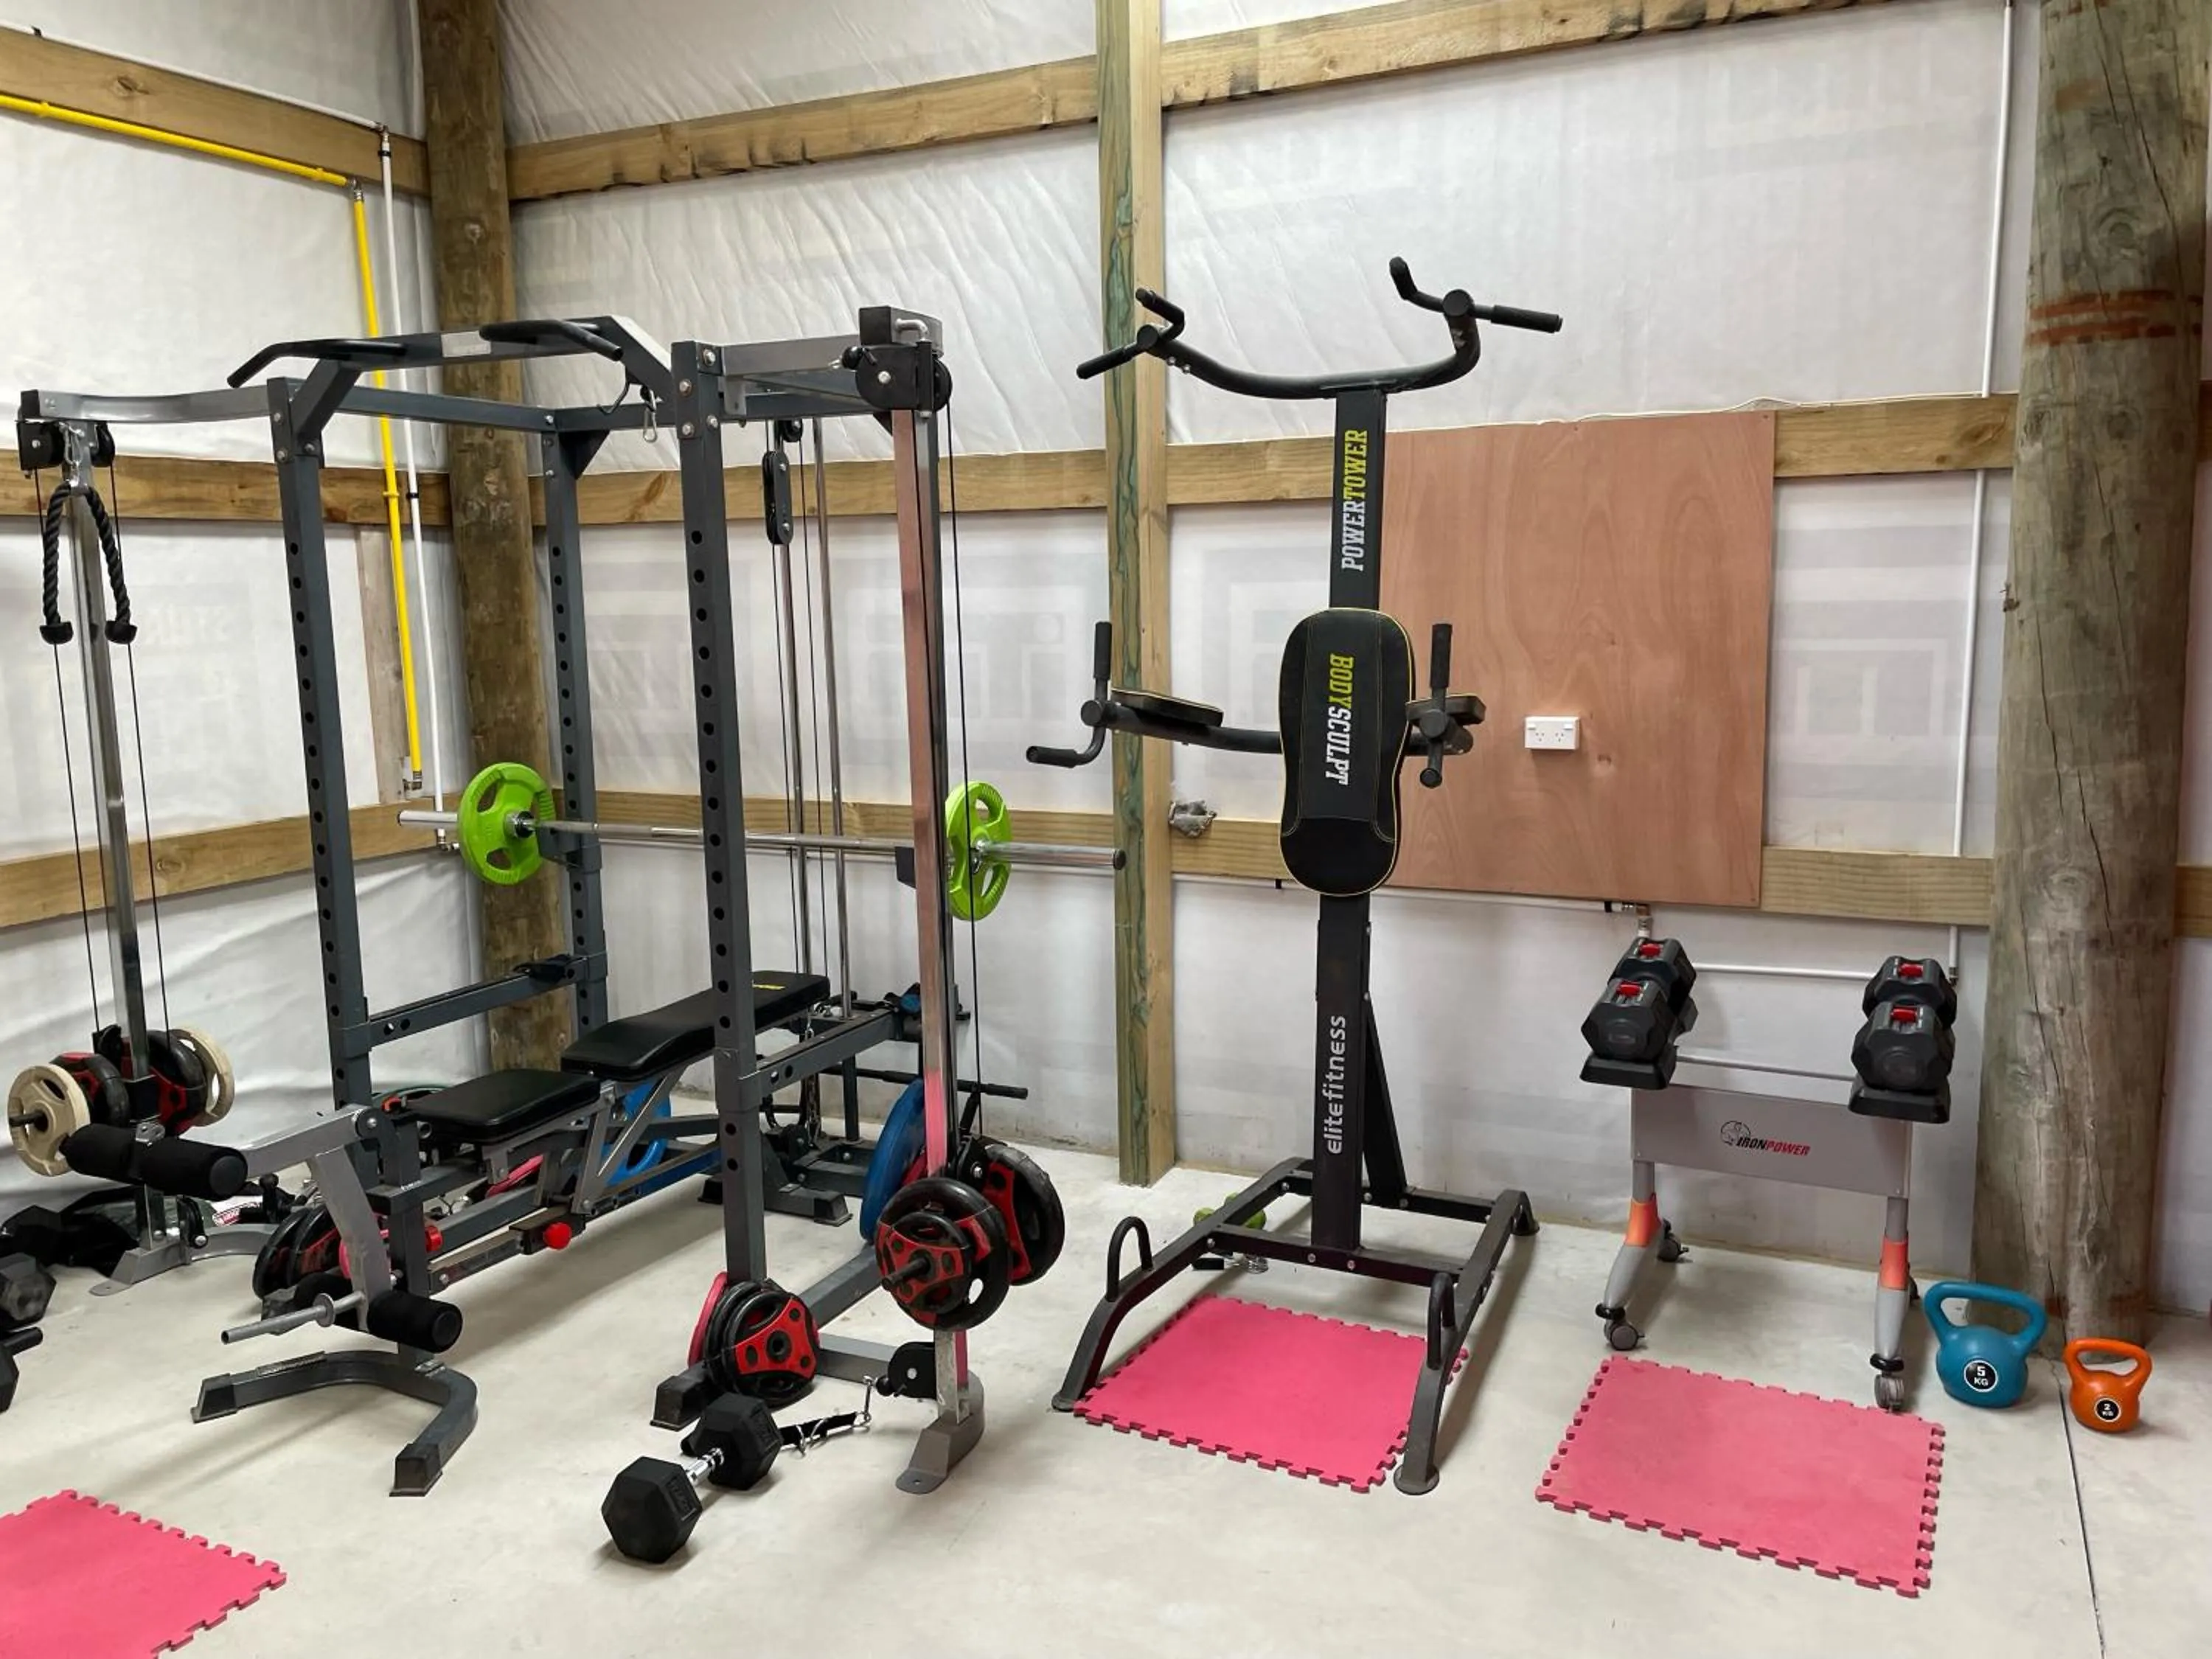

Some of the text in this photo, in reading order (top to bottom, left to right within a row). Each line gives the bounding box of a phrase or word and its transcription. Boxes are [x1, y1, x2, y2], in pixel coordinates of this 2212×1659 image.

[1322, 1015, 1346, 1154] elitefitness
[1977, 1366, 1986, 1377] 5
[1974, 1377, 1989, 1386] KG
